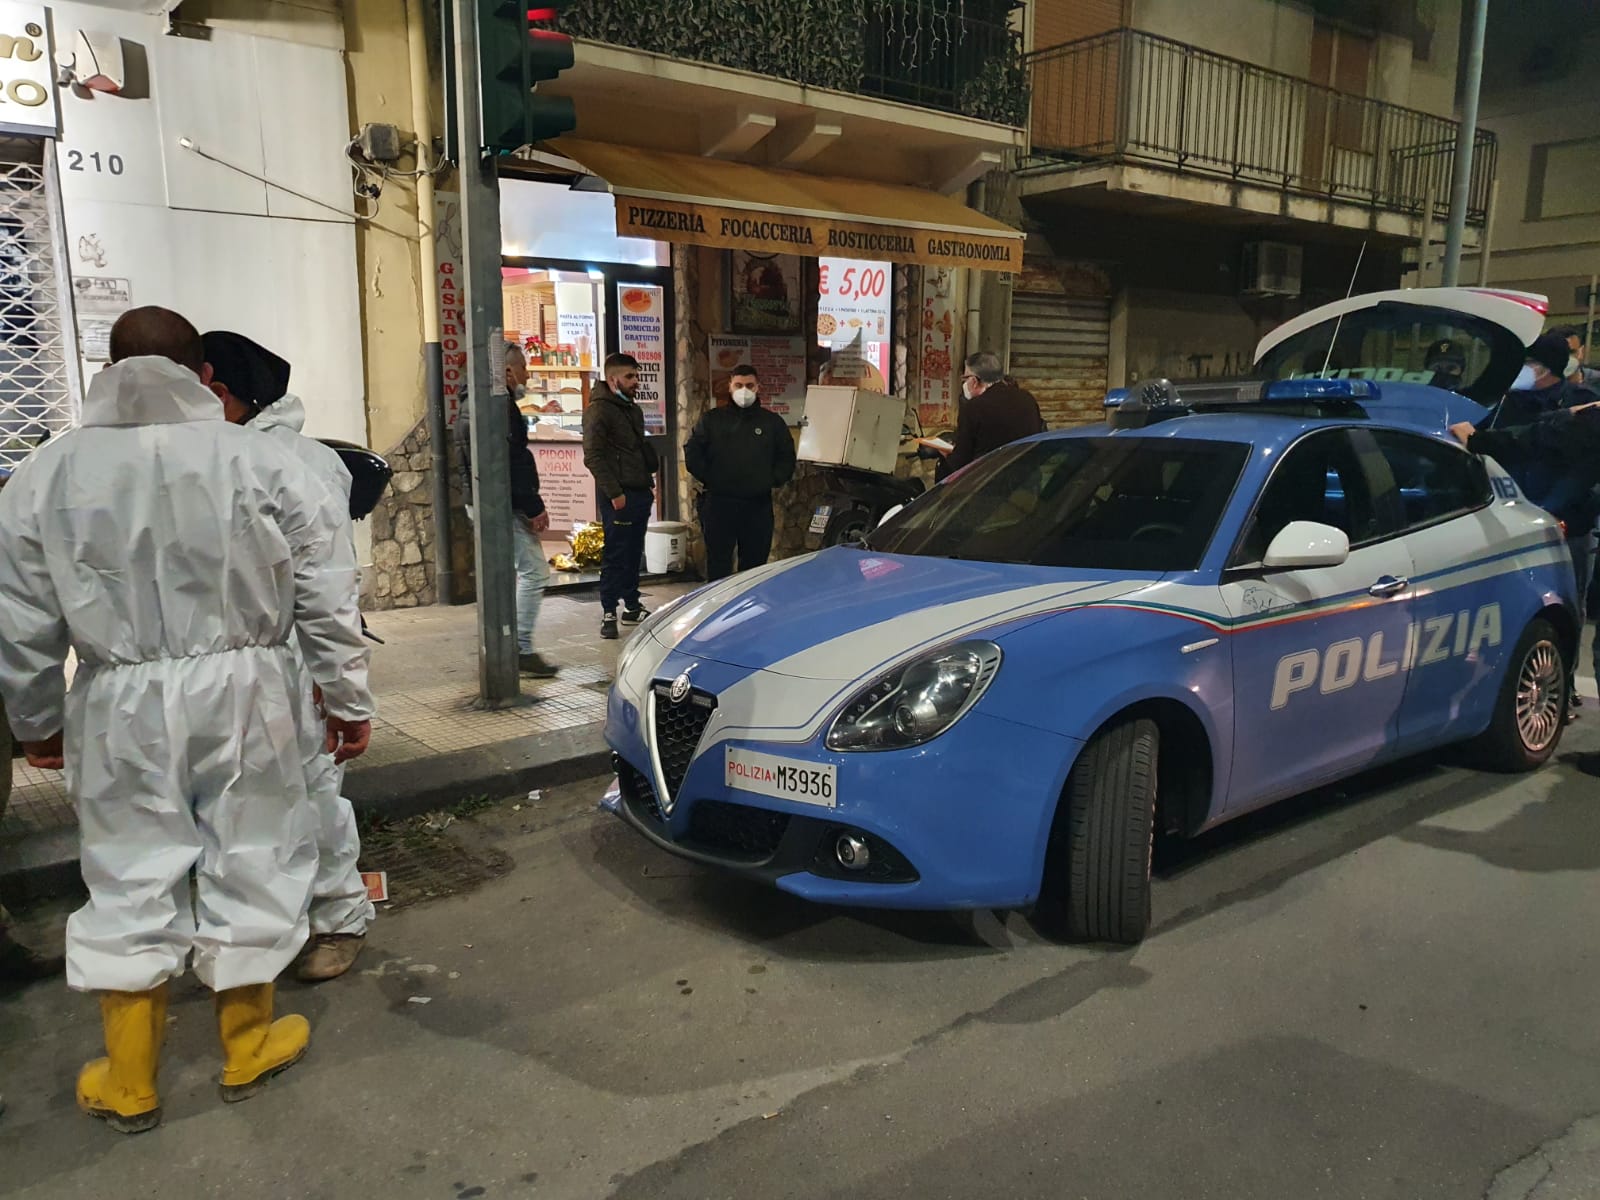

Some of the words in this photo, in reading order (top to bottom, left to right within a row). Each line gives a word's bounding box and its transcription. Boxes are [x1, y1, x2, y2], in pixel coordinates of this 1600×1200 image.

[67, 149, 124, 176] 210
[629, 206, 705, 233] PIZZERIA
[720, 217, 813, 244] FOCACCERIA
[828, 229, 915, 253] ROSTICCERIA
[928, 238, 1010, 261] GASTRONOMIA
[839, 267, 885, 300] 5,00
[624, 325, 660, 333] DOMICILIO
[624, 334, 660, 342] GRATUITO
[637, 363, 660, 372] STICI
[635, 391, 659, 400] ORNO
[539, 449, 576, 460] PIDONI
[545, 462, 572, 472] MAXI
[1270, 602, 1501, 711] POLIZIA
[728, 761, 771, 782] POLIZIA
[777, 765, 832, 798] M3936
